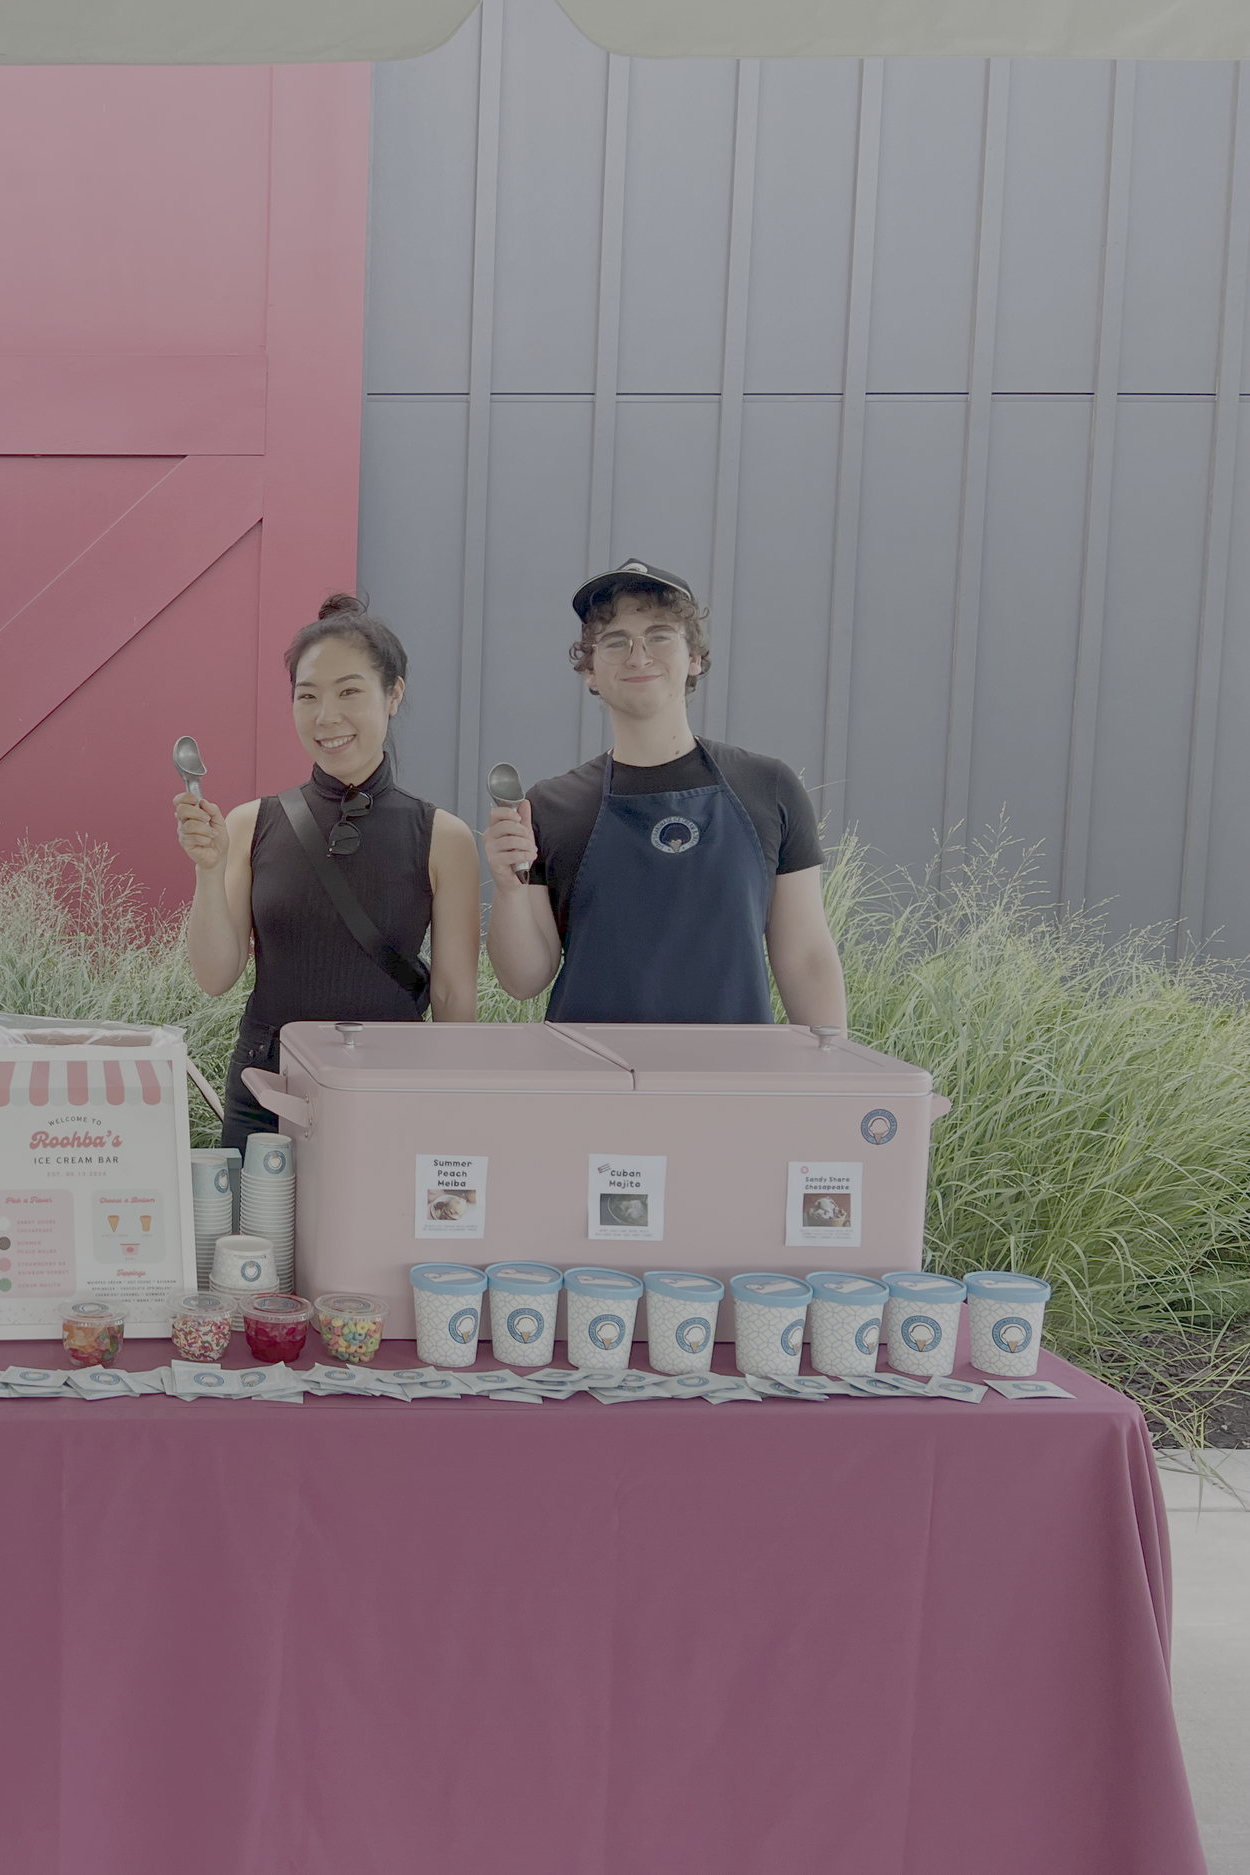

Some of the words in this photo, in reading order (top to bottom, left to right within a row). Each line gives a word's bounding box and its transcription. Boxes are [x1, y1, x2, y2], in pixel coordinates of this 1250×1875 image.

[48, 1116, 88, 1126] WELCOME
[92, 1118, 102, 1126] TO
[29, 1130, 123, 1150] Roohba's
[34, 1157, 51, 1165] ICE
[56, 1156, 93, 1164] CREAM
[98, 1156, 119, 1164] BAR
[433, 1159, 473, 1168] Summer
[437, 1169, 468, 1178] Peach
[437, 1179, 466, 1187] Melba
[608, 1179, 641, 1189] Mojito
[116, 1269, 146, 1278] Toppings
